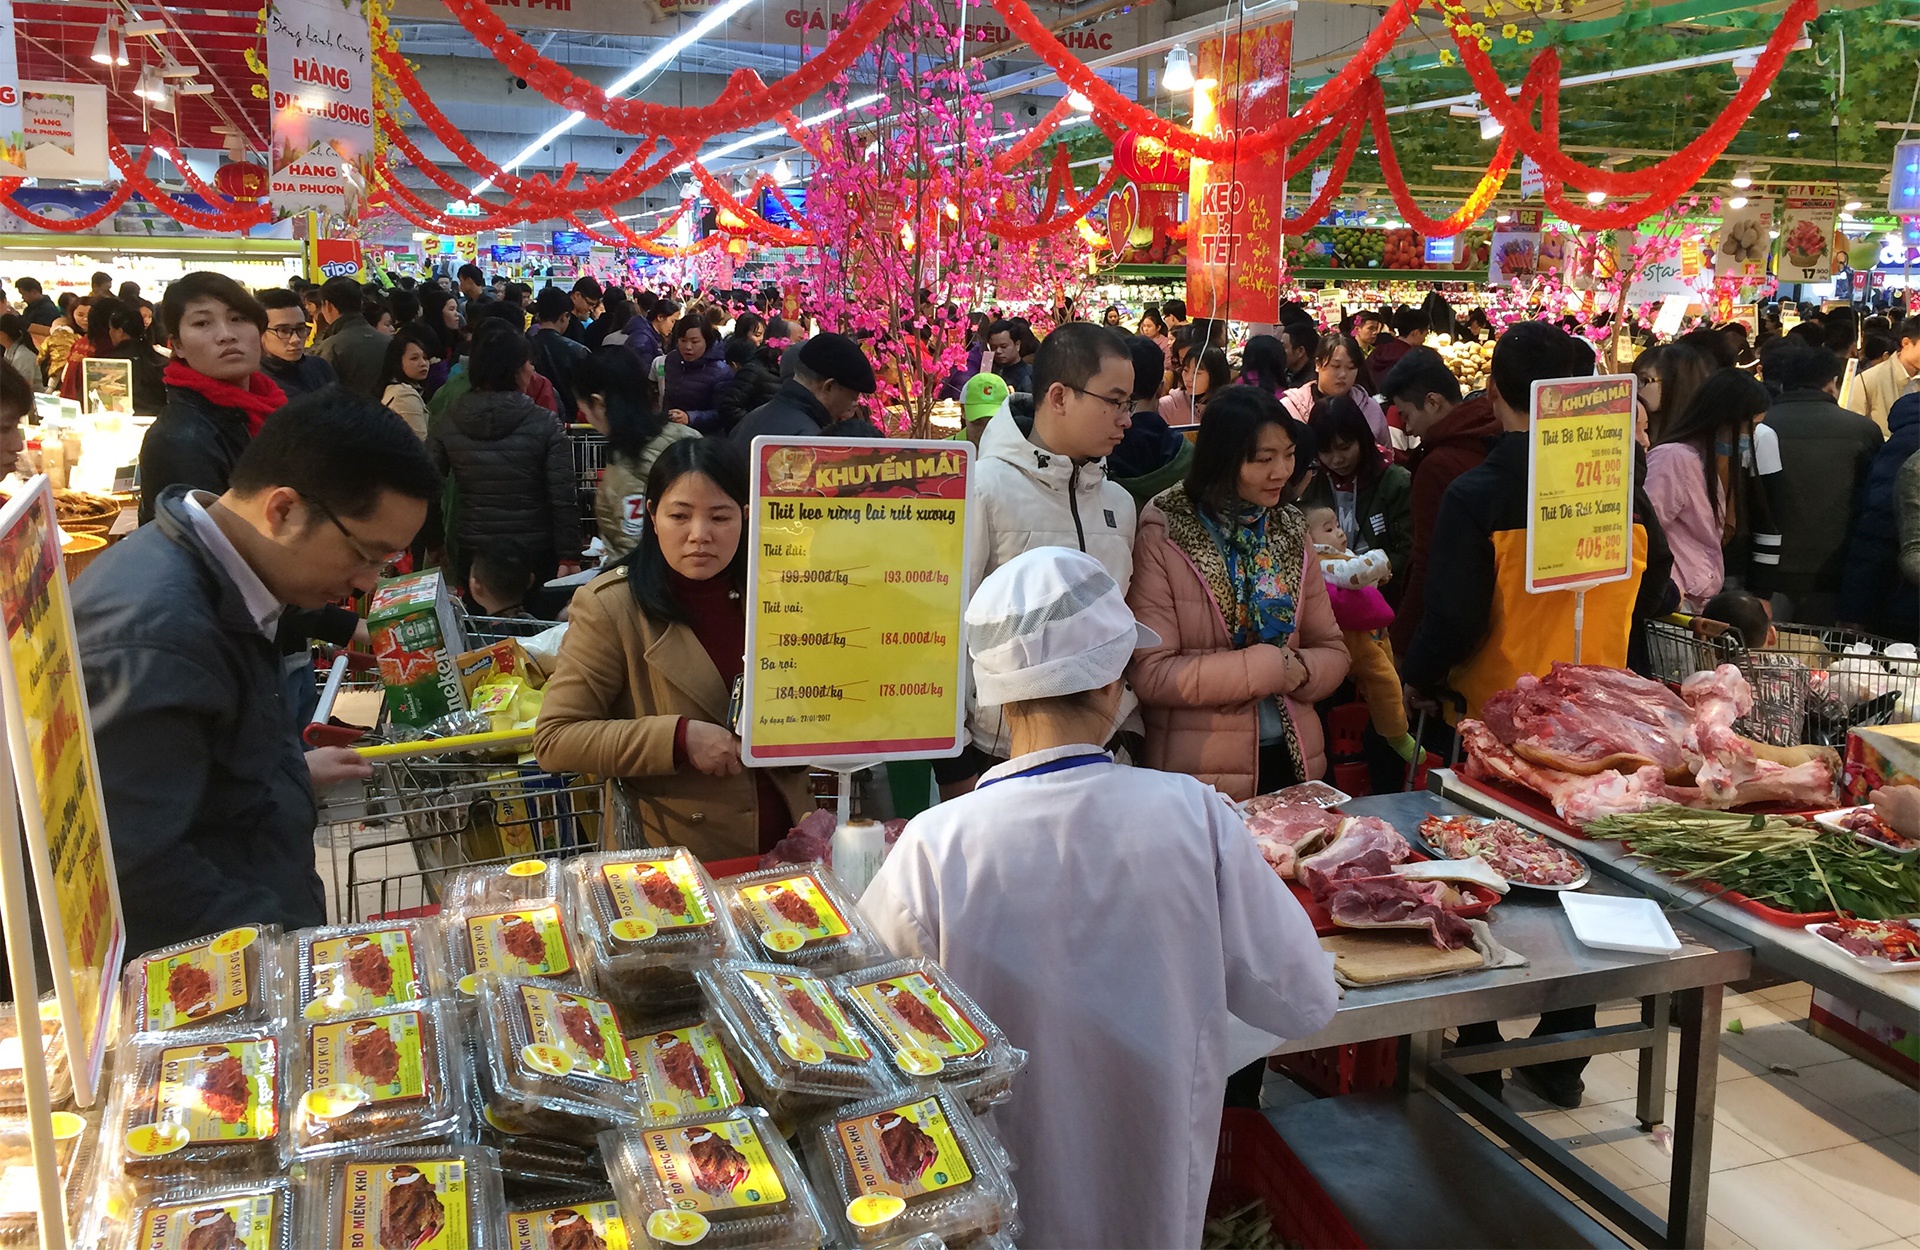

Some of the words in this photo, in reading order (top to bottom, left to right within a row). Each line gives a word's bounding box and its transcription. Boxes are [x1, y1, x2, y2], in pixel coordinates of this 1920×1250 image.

[293, 57, 350, 90] HÀNG
[289, 162, 337, 178] HÀNG
[299, 183, 345, 195] PHƯƠN
[1202, 223, 1242, 266] TẾT
[1802, 268, 1816, 279] 17
[1873, 275, 1882, 283] 16
[1562, 387, 1608, 412] KHUYẾN
[815, 455, 912, 488] KHUYẾN
[799, 502, 824, 520] heo
[827, 505, 861, 524] rừng
[866, 503, 886, 521] lai
[890, 504, 913, 521] rút
[780, 570, 849, 586] 199.900đ/kg
[884, 570, 949, 585] 193.000đ/kg
[784, 601, 804, 613] vai:
[779, 632, 846, 648] 189.900đ/kg
[881, 631, 946, 646] 184.000đ/kg
[760, 657, 776, 670] Ba
[779, 658, 798, 673] rọi:
[776, 684, 843, 701] 184.900đ/kg
[879, 682, 943, 697] 178.000đ/kg
[316, 1036, 329, 1057] KHÔ
[652, 1134, 669, 1152] KHÔ
[846, 1124, 862, 1143] KHÔ
[659, 1153, 678, 1181] MIẾNG
[852, 1144, 871, 1176] MIẾNG
[353, 1169, 368, 1191] KHÔ
[670, 1182, 685, 1195] BÒ
[862, 1175, 878, 1187] BÒ
[348, 1195, 366, 1229] MIẾNG
[152, 1213, 169, 1239] KHÔ
[514, 1218, 530, 1237] KHÔ
[349, 1234, 364, 1249] BÒ
